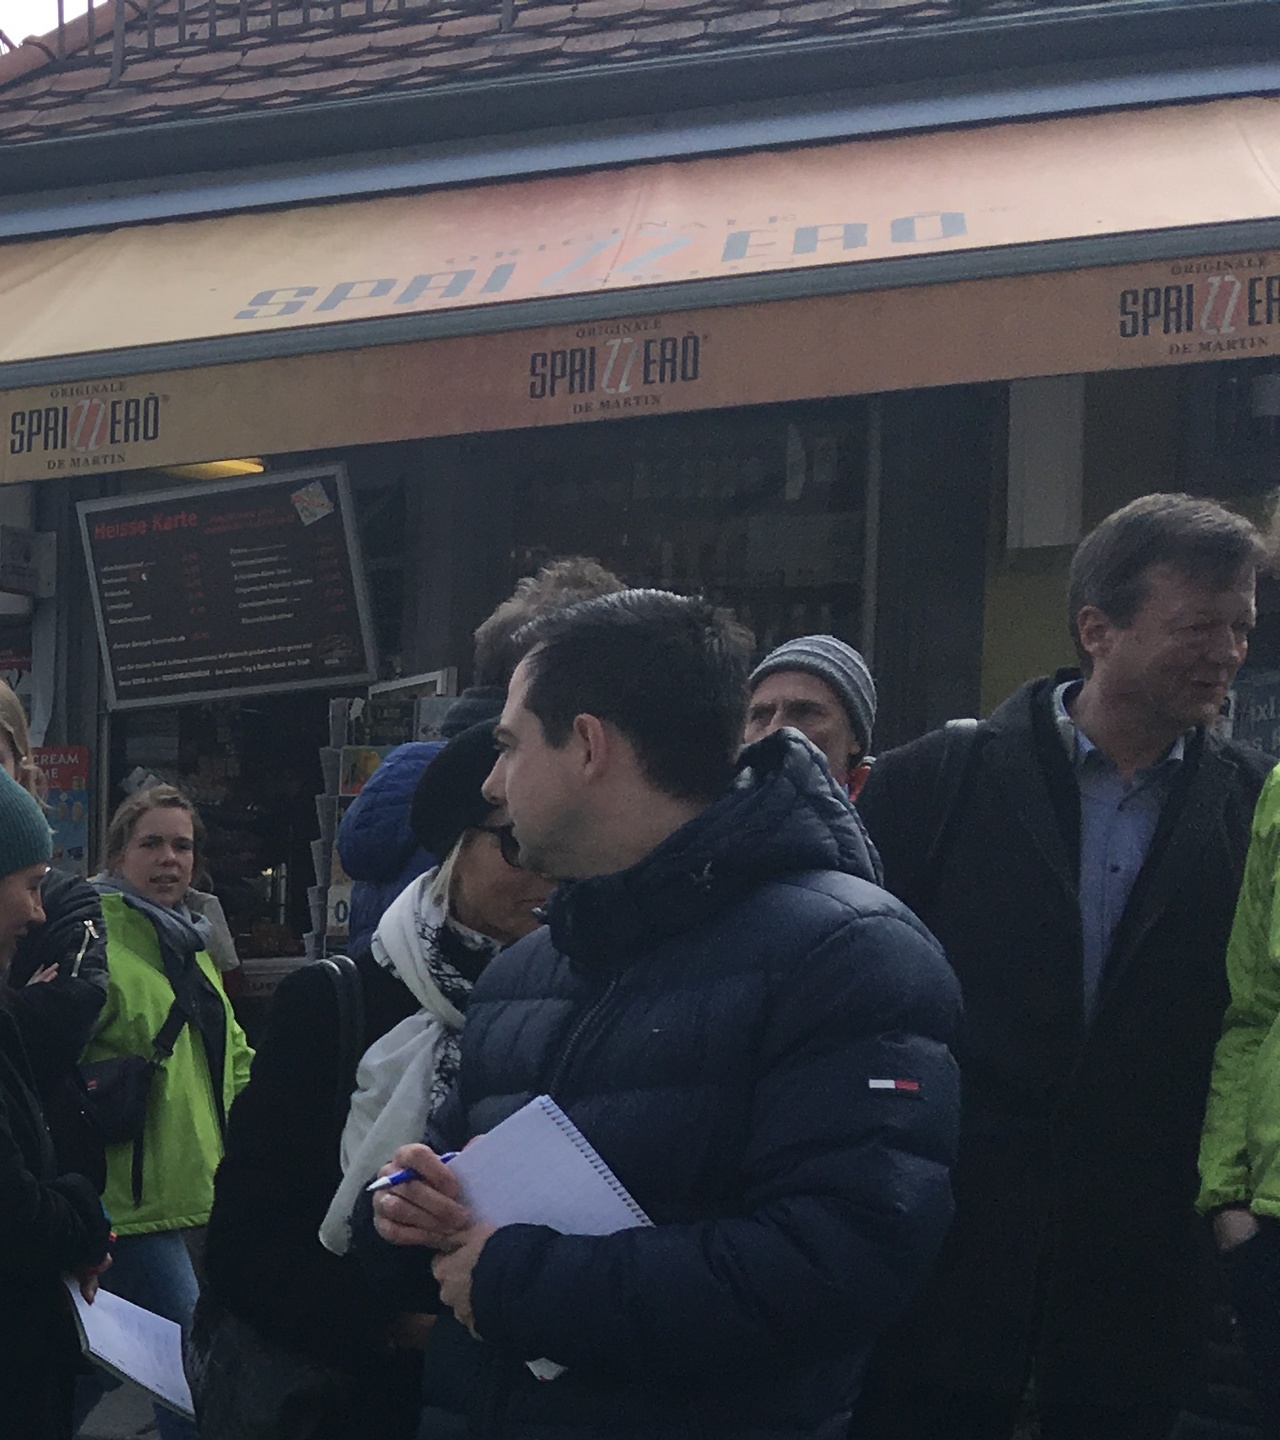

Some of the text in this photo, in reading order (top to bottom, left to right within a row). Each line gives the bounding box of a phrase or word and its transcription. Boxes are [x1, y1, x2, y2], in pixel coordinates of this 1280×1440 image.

[1171, 256, 1267, 275] ORIGINALE
[576, 319, 661, 338] ORIGINALE
[1169, 337, 1268, 355] DE MARTIN
[50, 382, 127, 399] ORIGINALE
[573, 395, 661, 414] DE MARTIN
[47, 453, 126, 470] DE MARTIN
[152, 511, 197, 531] Karte
[32, 754, 79, 765] CREAM
